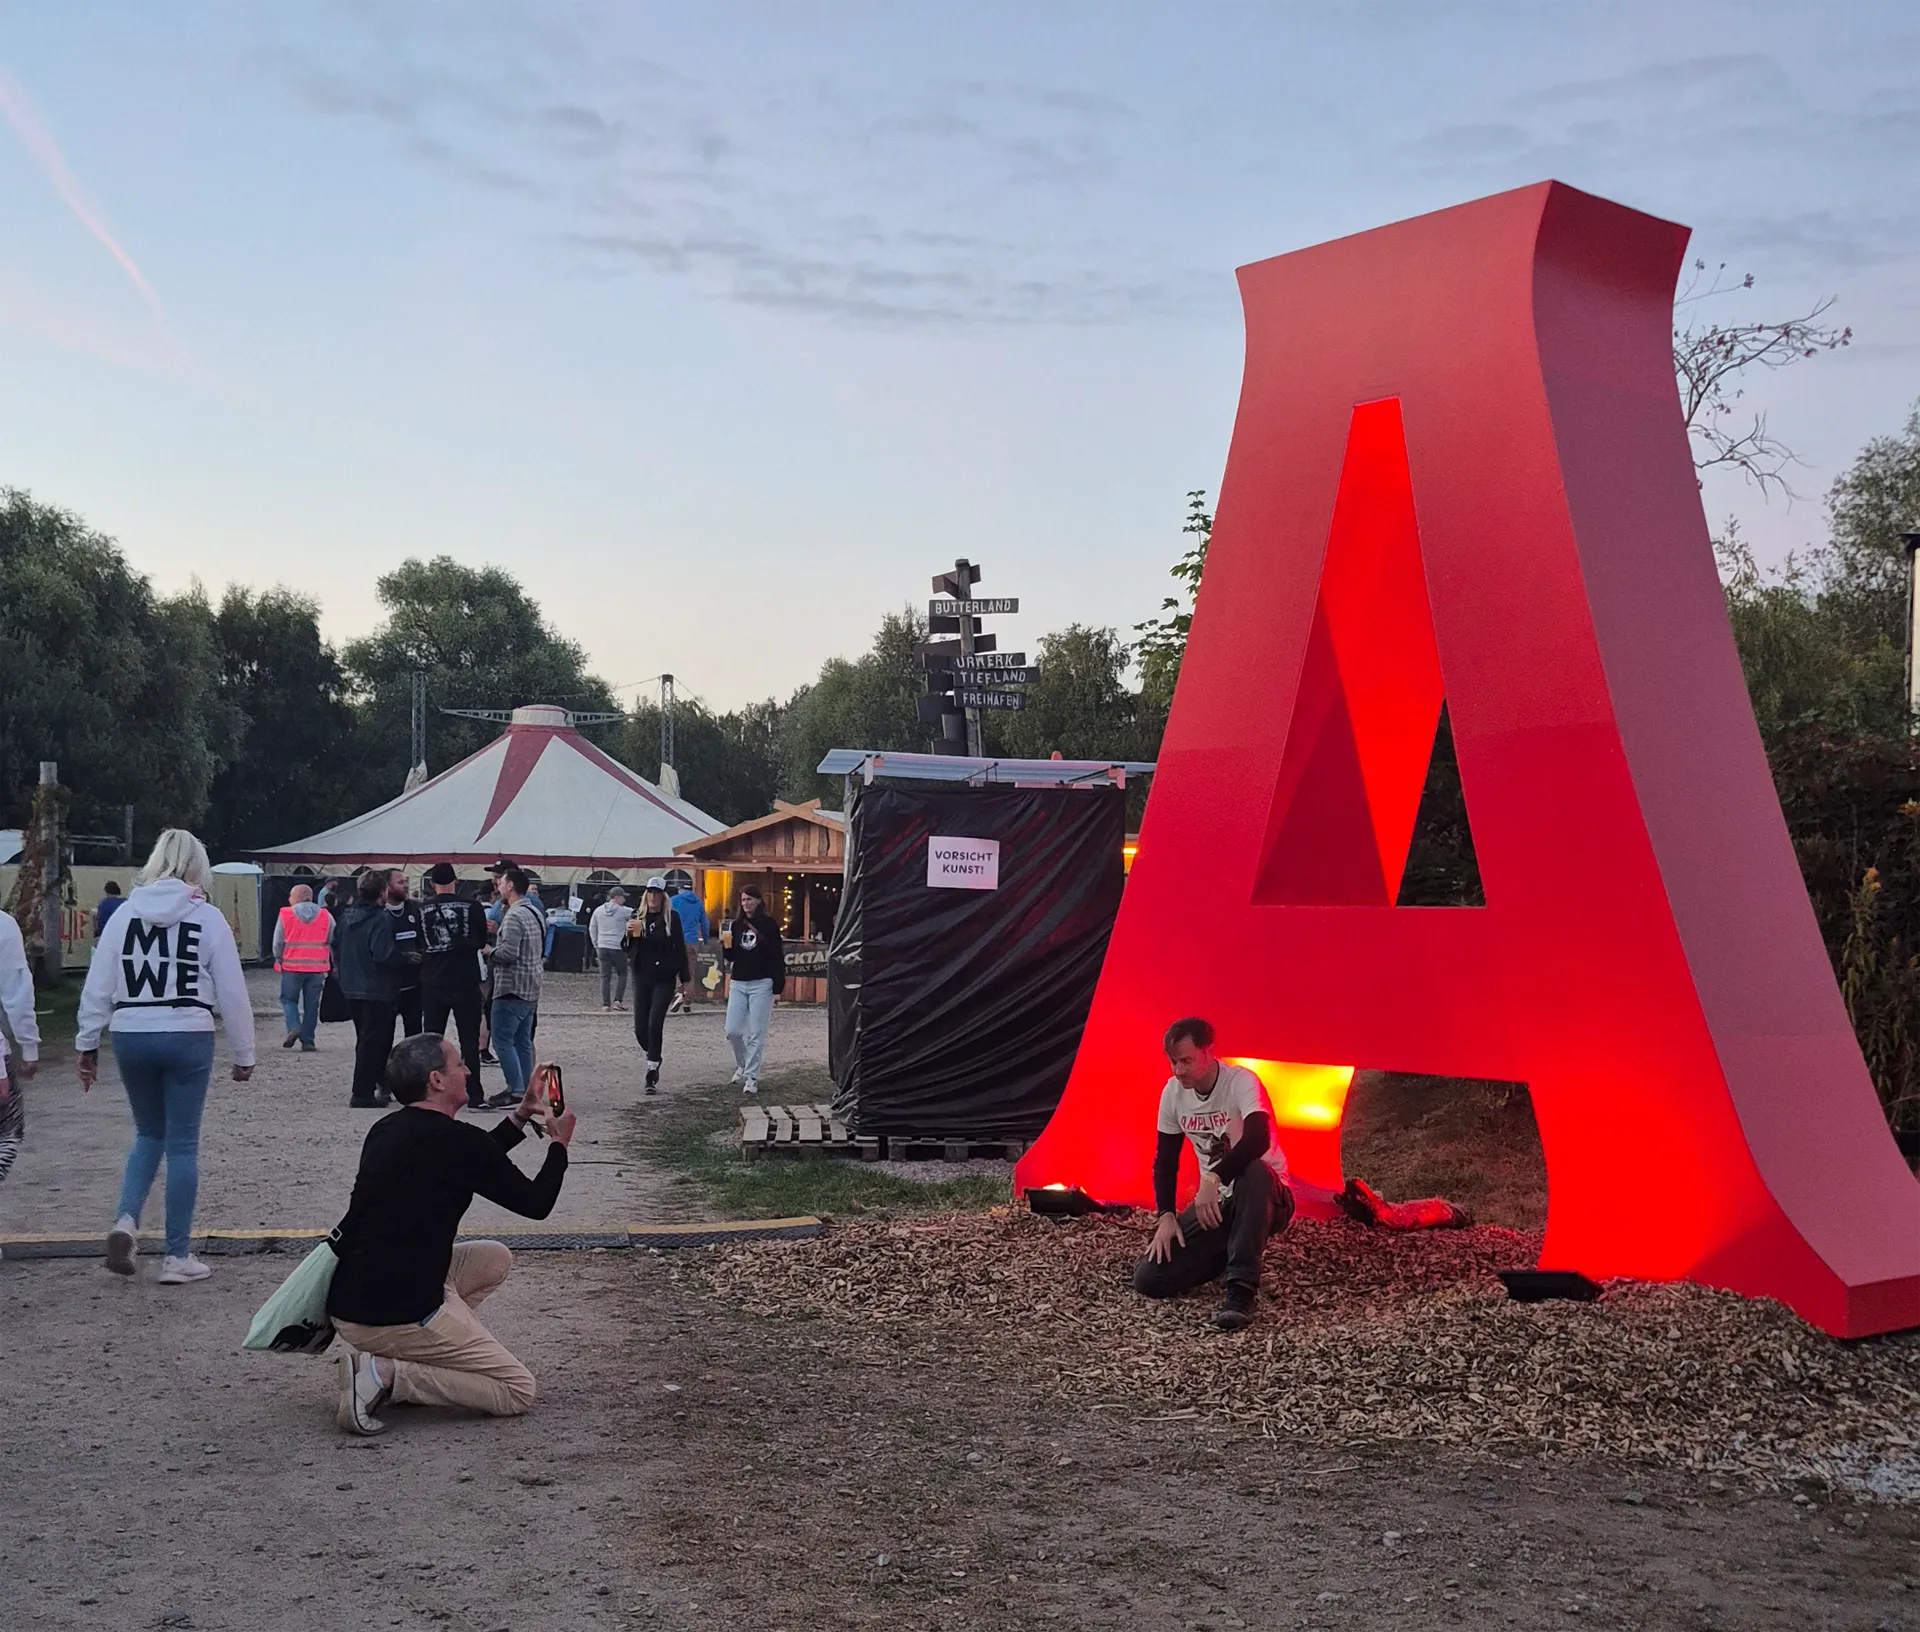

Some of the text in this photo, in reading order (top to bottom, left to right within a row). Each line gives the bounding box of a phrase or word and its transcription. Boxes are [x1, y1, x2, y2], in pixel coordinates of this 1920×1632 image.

[935, 600, 1011, 615] BUTTERLAND
[956, 654, 1014, 669] URWERK
[960, 670, 1026, 685] TIEFLAND
[962, 692, 1020, 709] FREIHAFEN
[1016, 180, 1920, 1340] A
[934, 850, 993, 862] VORSICHT
[942, 864, 984, 875] KUNST!
[122, 918, 202, 960] ME
[122, 960, 200, 998] WE
